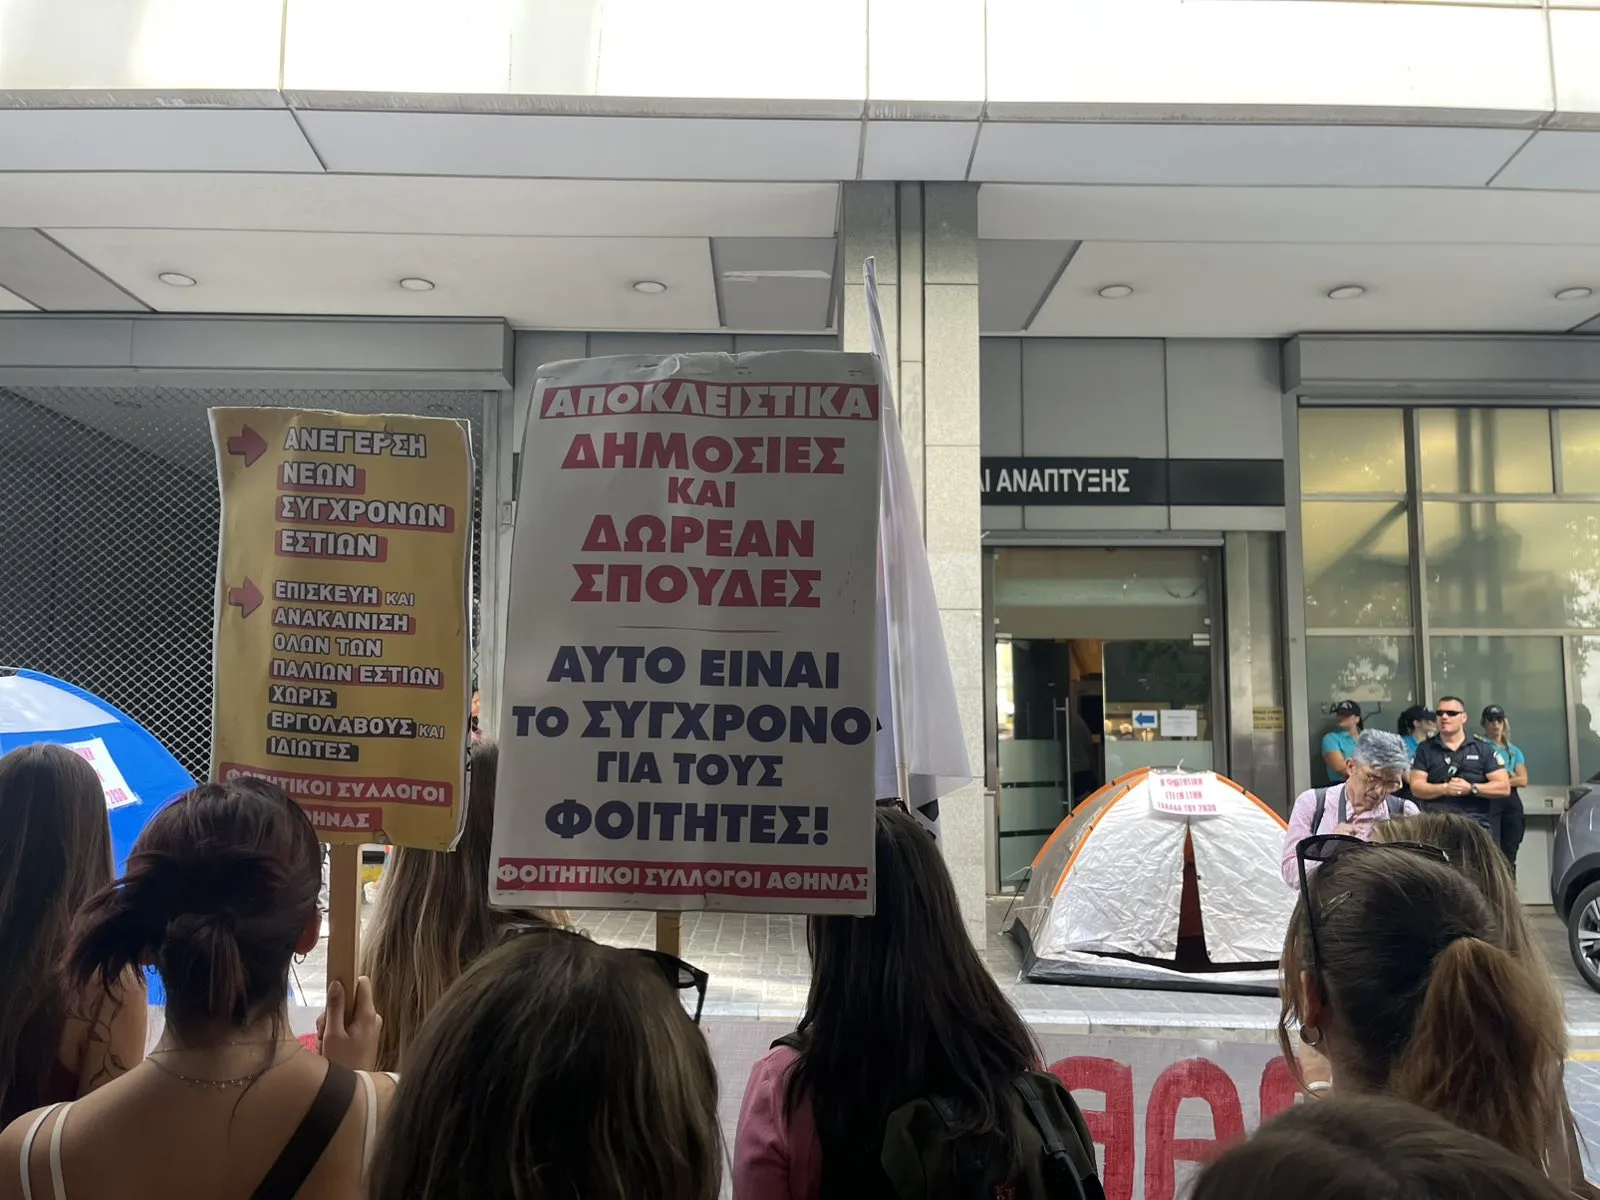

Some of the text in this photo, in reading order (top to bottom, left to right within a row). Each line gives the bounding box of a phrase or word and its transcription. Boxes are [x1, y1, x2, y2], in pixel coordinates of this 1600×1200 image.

[545, 383, 874, 419] ΑΠΟΚΛΕΙΣΤΙΚΑ
[283, 427, 427, 458] ΑΝΕΓΕΡΣΗ
[561, 431, 846, 475] ΔΗΜΟΣΙΕΣ
[282, 461, 356, 488] ΝΕΩΝ
[996, 468, 1130, 493] ΑΝΑΠΤΥΞΗΣ
[667, 476, 736, 508] ΚΑΙ
[280, 495, 447, 528] ΣΥΓΧΡΟΝΩΝ
[280, 527, 378, 557] ΕΣΤΙΩΝ
[581, 514, 815, 558] ΔΩΡΕΑΝ
[274, 580, 416, 607] ΕΠΙΣΚΕΥΗ ΚΑΙ
[570, 563, 822, 608] ΣΠΟΥΔΕΣ
[273, 607, 410, 632] ΑΝΑΚΑΙΝΙΣΗ
[272, 633, 383, 658] ΟΛΩΝ ΤΩΝ
[272, 659, 441, 687] ΠΑΛΙΩΝ ΕΣΤΙΩΝ
[546, 645, 840, 689] ΑΥΤΟ ΕΙΝΑΙ
[271, 685, 333, 707] ΧΩΡΙΣ
[270, 710, 446, 739] ΕΡΓΟΛΑΒΟΥΣ ΚΑΙ
[512, 700, 872, 746] ΤΟ ΣΥΓΧΡΟΝΟ
[270, 736, 352, 760] ΙΔΙΩΤΕΣ
[597, 750, 783, 787] ΓΙΑ ΤΟΥΣ
[337, 781, 446, 802] ΣΥΛΛΟΓΟΙ
[544, 798, 829, 846] ΦΟΙΤΗΤΕΣ!
[498, 863, 869, 892] ΦΟΙΤΗΤΙΚΟΙ ΣΥΛΛΟΓΟΙ ΑΘΗΝΑΣ
